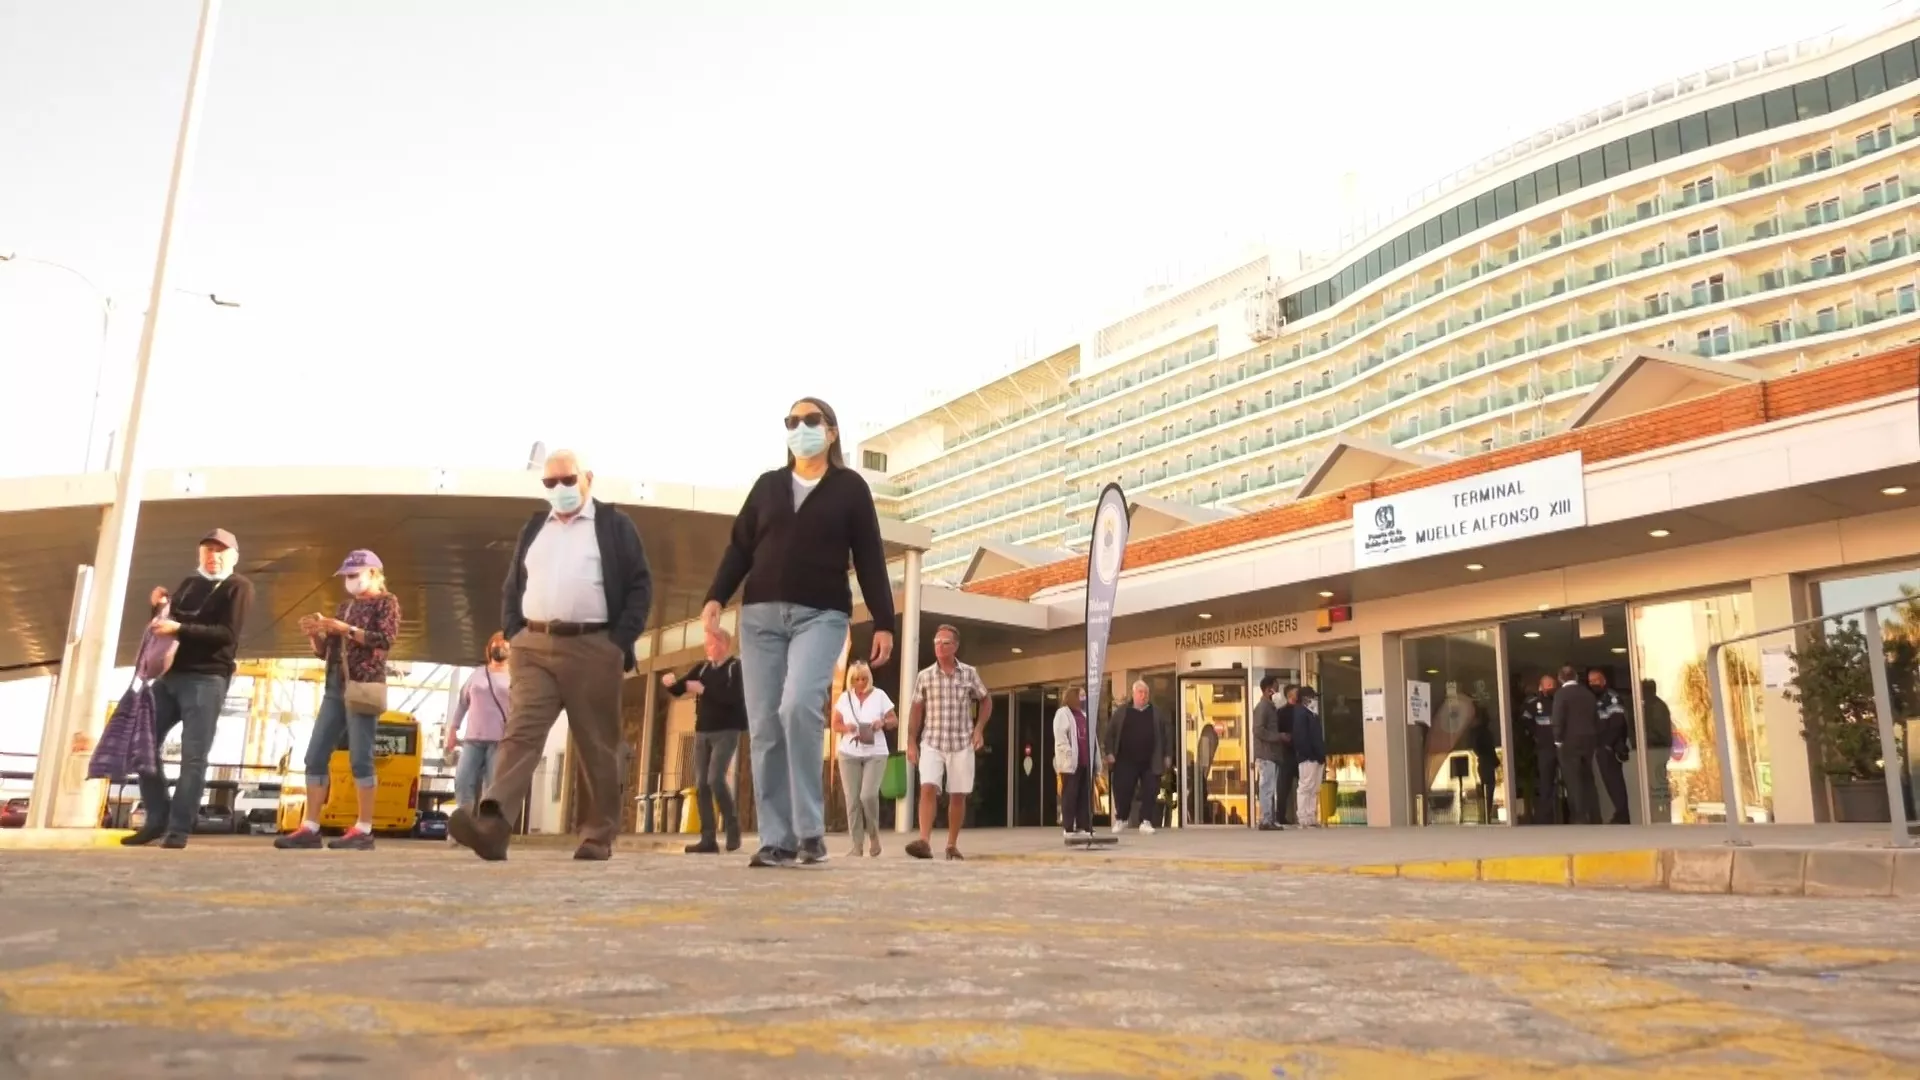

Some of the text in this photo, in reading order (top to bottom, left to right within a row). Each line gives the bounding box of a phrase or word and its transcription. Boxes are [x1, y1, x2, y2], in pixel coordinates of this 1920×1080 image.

[1452, 480, 1525, 509] TERMINAL
[1416, 498, 1572, 544] MUELLE ALFONSO XIII
[1175, 630, 1225, 650] PASAJEROS
[1234, 618, 1298, 641] PASSENGERS
